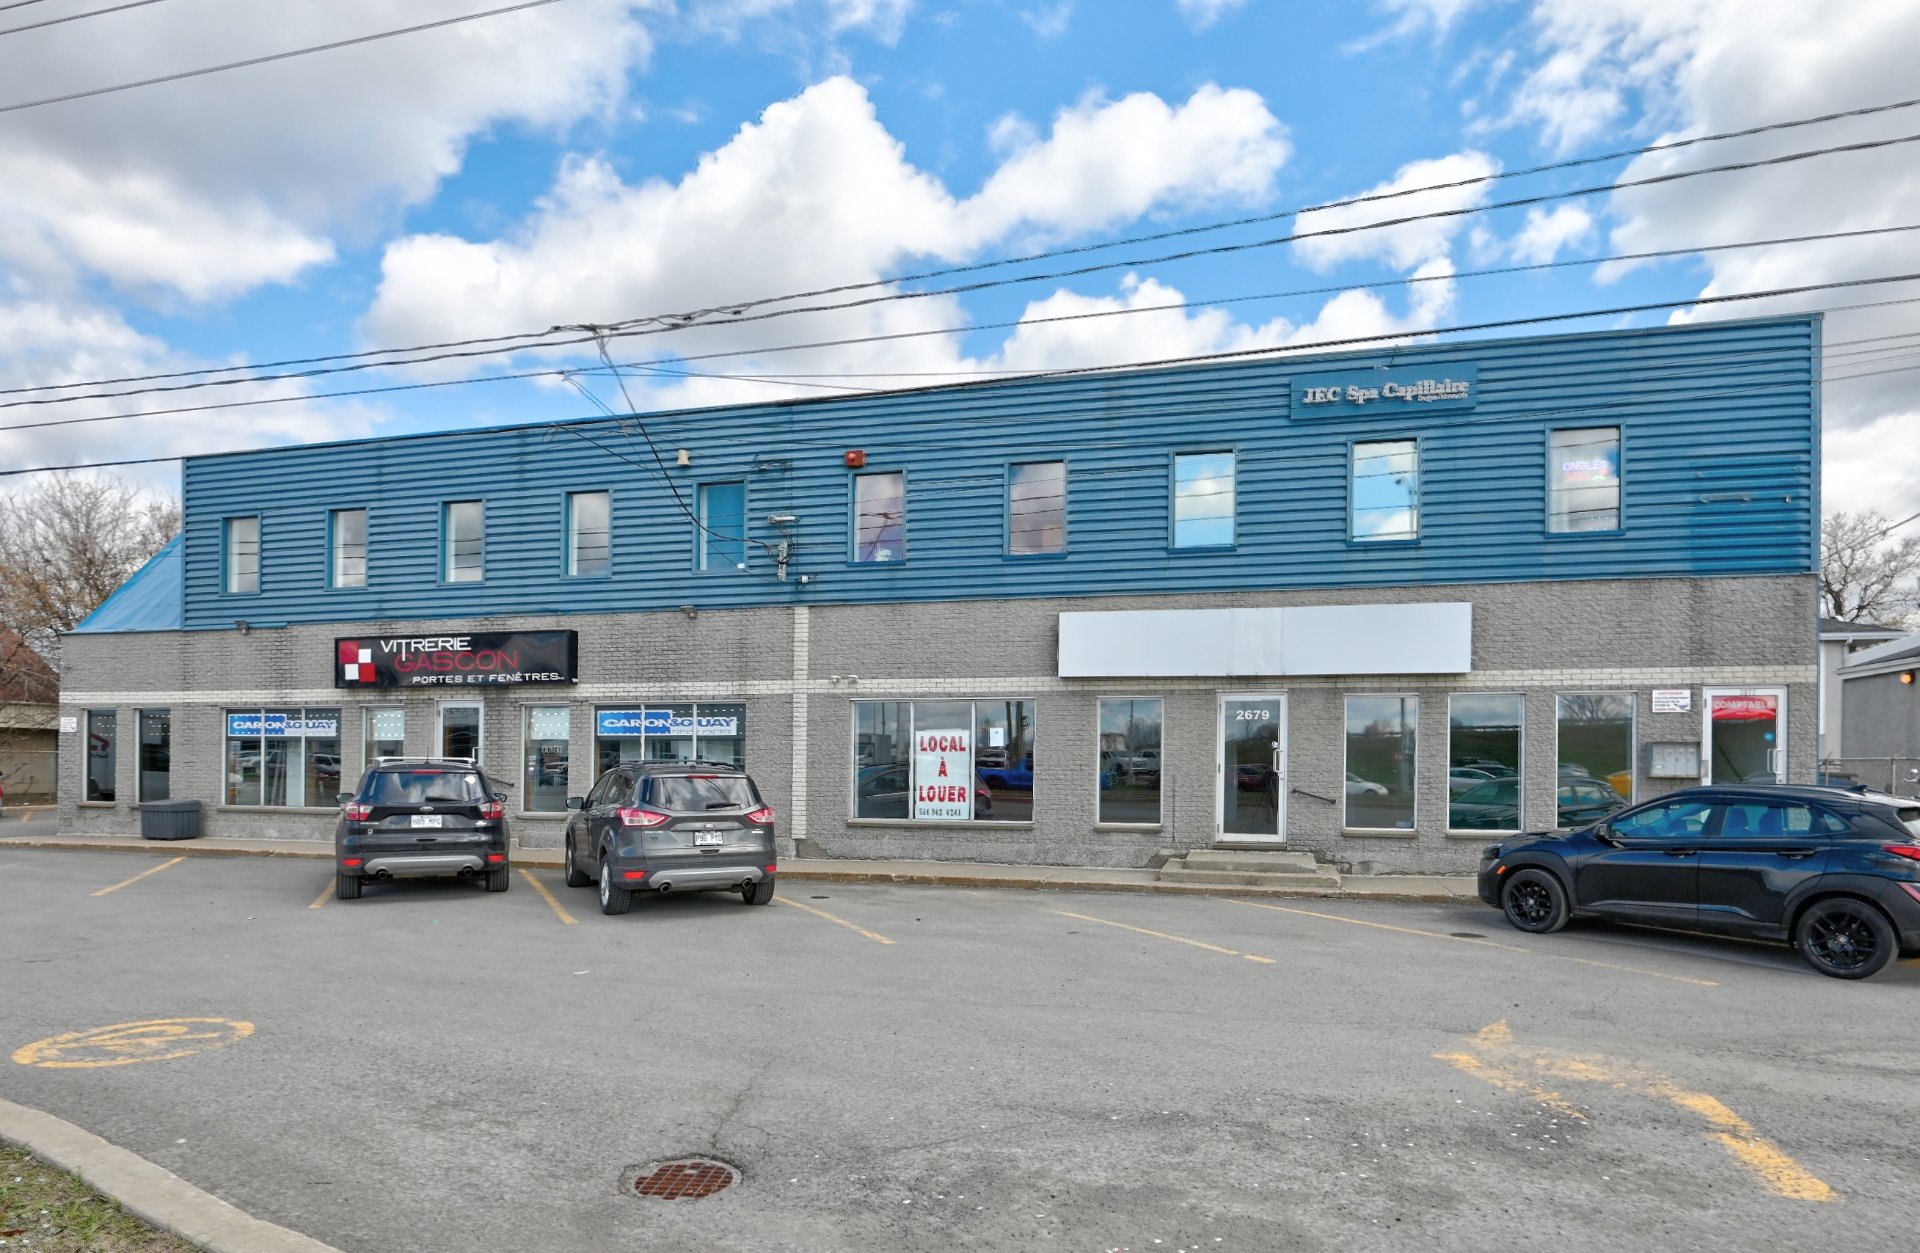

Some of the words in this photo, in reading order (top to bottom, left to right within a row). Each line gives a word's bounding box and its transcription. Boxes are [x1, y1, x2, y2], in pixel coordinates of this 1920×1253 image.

[1302, 386, 1341, 403] JEC
[1346, 385, 1379, 404] Spa
[1382, 379, 1469, 400] Capillaire
[1562, 460, 1609, 471] ONGLES
[380, 637, 472, 661] VITRERIE
[394, 650, 519, 672] GASCON
[412, 674, 464, 684] PORTES
[467, 674, 482, 683] ET
[489, 671, 559, 682] FENÊTRES
[1236, 710, 1270, 720] 2679
[541, 745, 564, 754] OUVERT
[920, 736, 966, 752] LOCAL
[938, 756, 948, 777] À
[919, 786, 967, 803] LOUER
